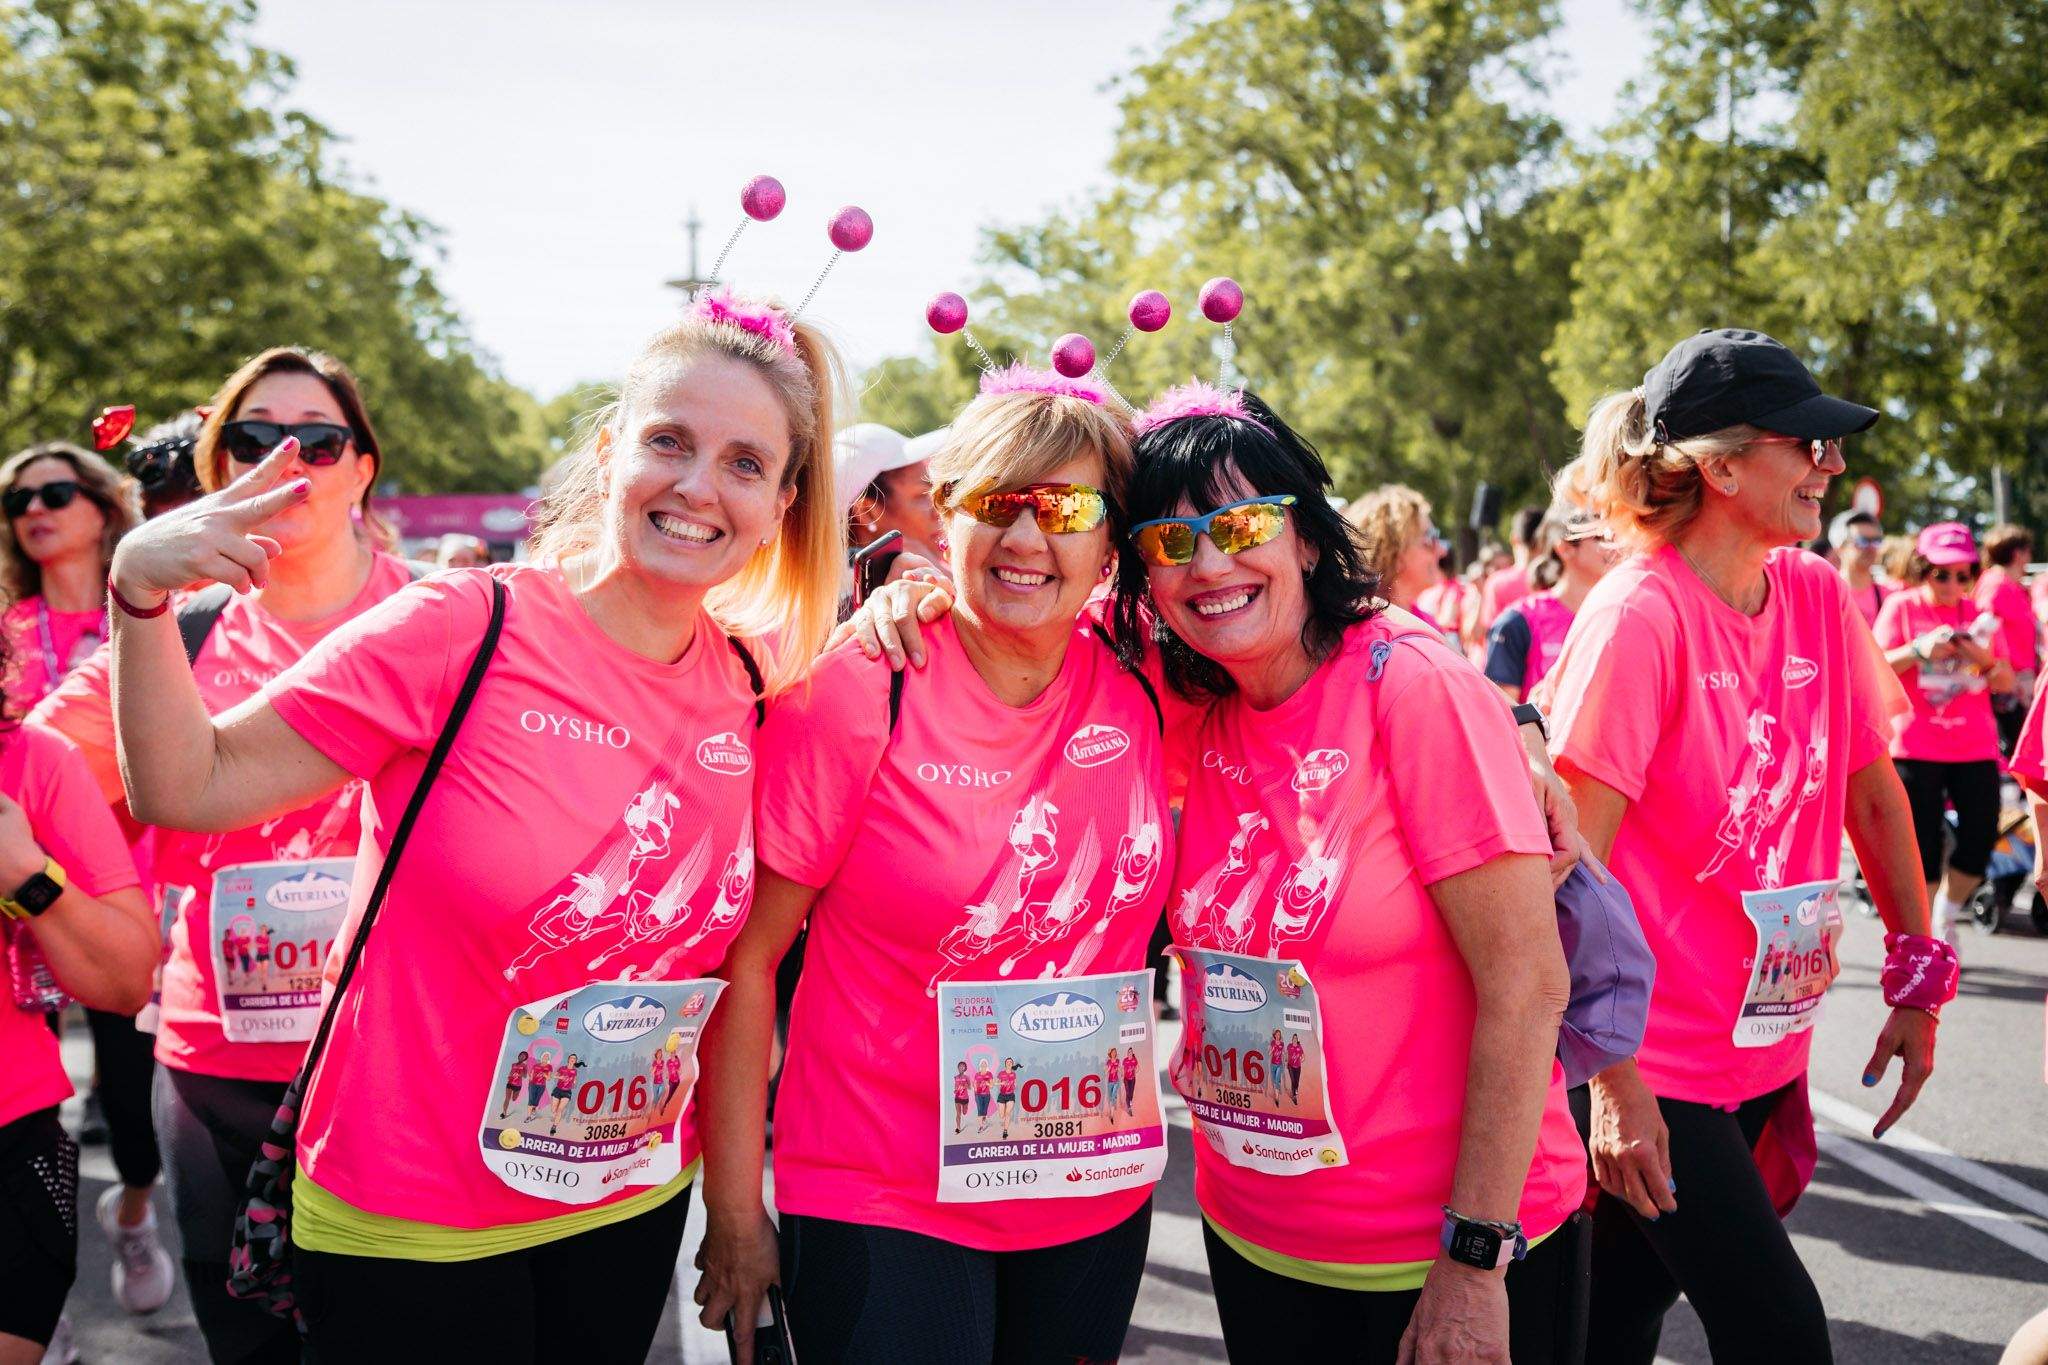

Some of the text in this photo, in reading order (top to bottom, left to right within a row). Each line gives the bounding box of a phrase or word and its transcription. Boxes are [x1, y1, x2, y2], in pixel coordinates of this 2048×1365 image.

[520, 710, 631, 749] OYSHO
[1071, 737, 1127, 760] ASTURIANA
[917, 763, 1012, 788] OYSHO
[274, 887, 346, 903] ASTURIANA
[274, 939, 334, 970] 01
[1793, 949, 1823, 980] 016
[590, 1011, 658, 1032] ASTURIANA
[953, 1005, 994, 1018] SUMA
[1018, 1011, 1100, 1032] ASTURIANA
[1204, 1044, 1264, 1085] 016
[577, 1075, 648, 1115] 016
[1020, 1074, 1102, 1113] 016
[1215, 1088, 1251, 1109] 30885
[584, 1123, 627, 1140] 30884
[1034, 1121, 1083, 1138] 30881
[1210, 1107, 1220, 1120] DE
[1221, 1110, 1232, 1122] LA
[1233, 1112, 1260, 1128] MUJER
[1267, 1118, 1303, 1134] MADRID
[518, 1136, 565, 1156] ARRERA
[568, 1145, 583, 1158] DE
[586, 1146, 598, 1158] LA
[600, 1141, 629, 1157] MUJER
[968, 1133, 1141, 1159] CARRERA DE LA MUJER MADRID
[1255, 1144, 1314, 1161] Santander
[504, 1161, 580, 1188] OYSHO
[966, 1168, 1038, 1189] OYSHO
[1085, 1162, 1145, 1181] Santander
